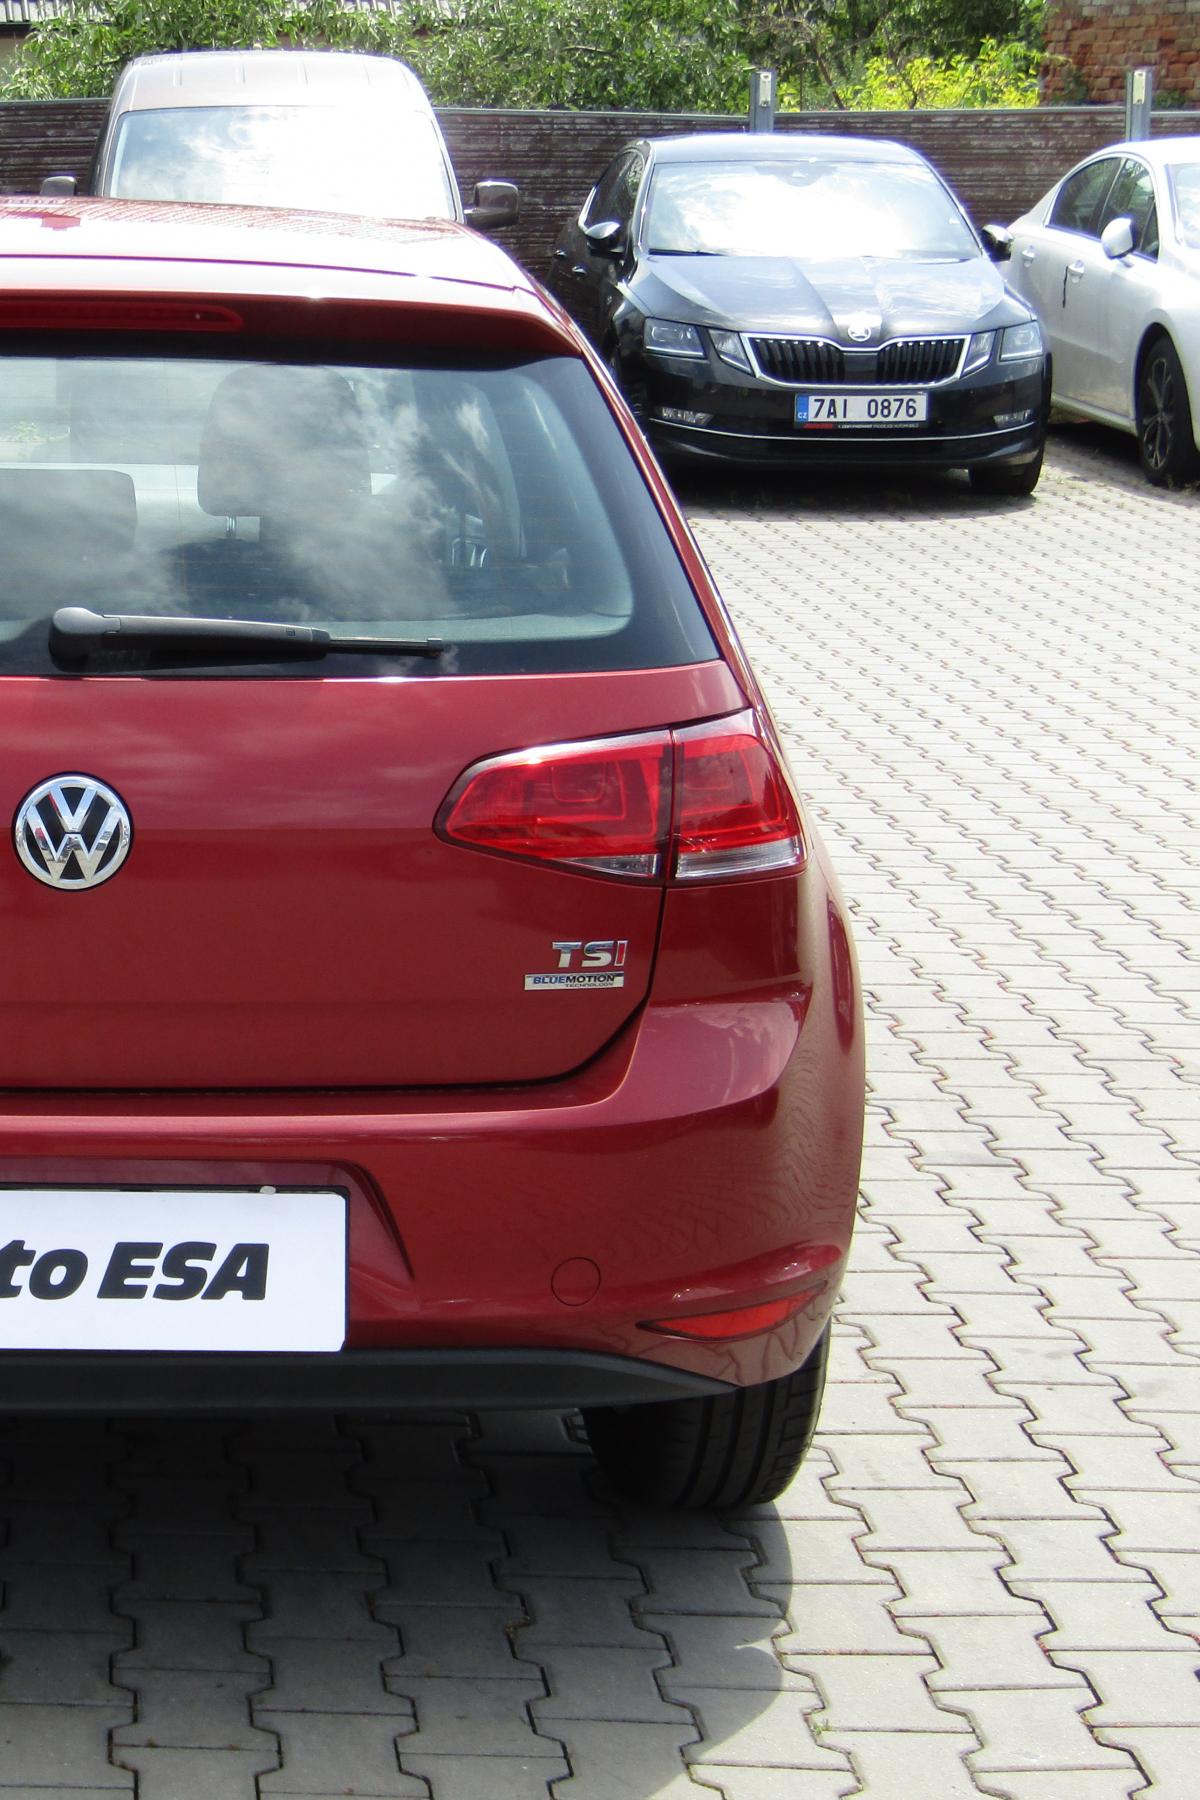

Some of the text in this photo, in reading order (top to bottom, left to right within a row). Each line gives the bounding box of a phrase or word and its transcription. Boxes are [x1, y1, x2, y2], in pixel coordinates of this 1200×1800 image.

[797, 412, 808, 420] CZ
[813, 398, 918, 419] 7AI 0876
[551, 939, 629, 969] TSI
[533, 974, 615, 985] BLUEMOTION
[96, 1241, 271, 1301] ESA
